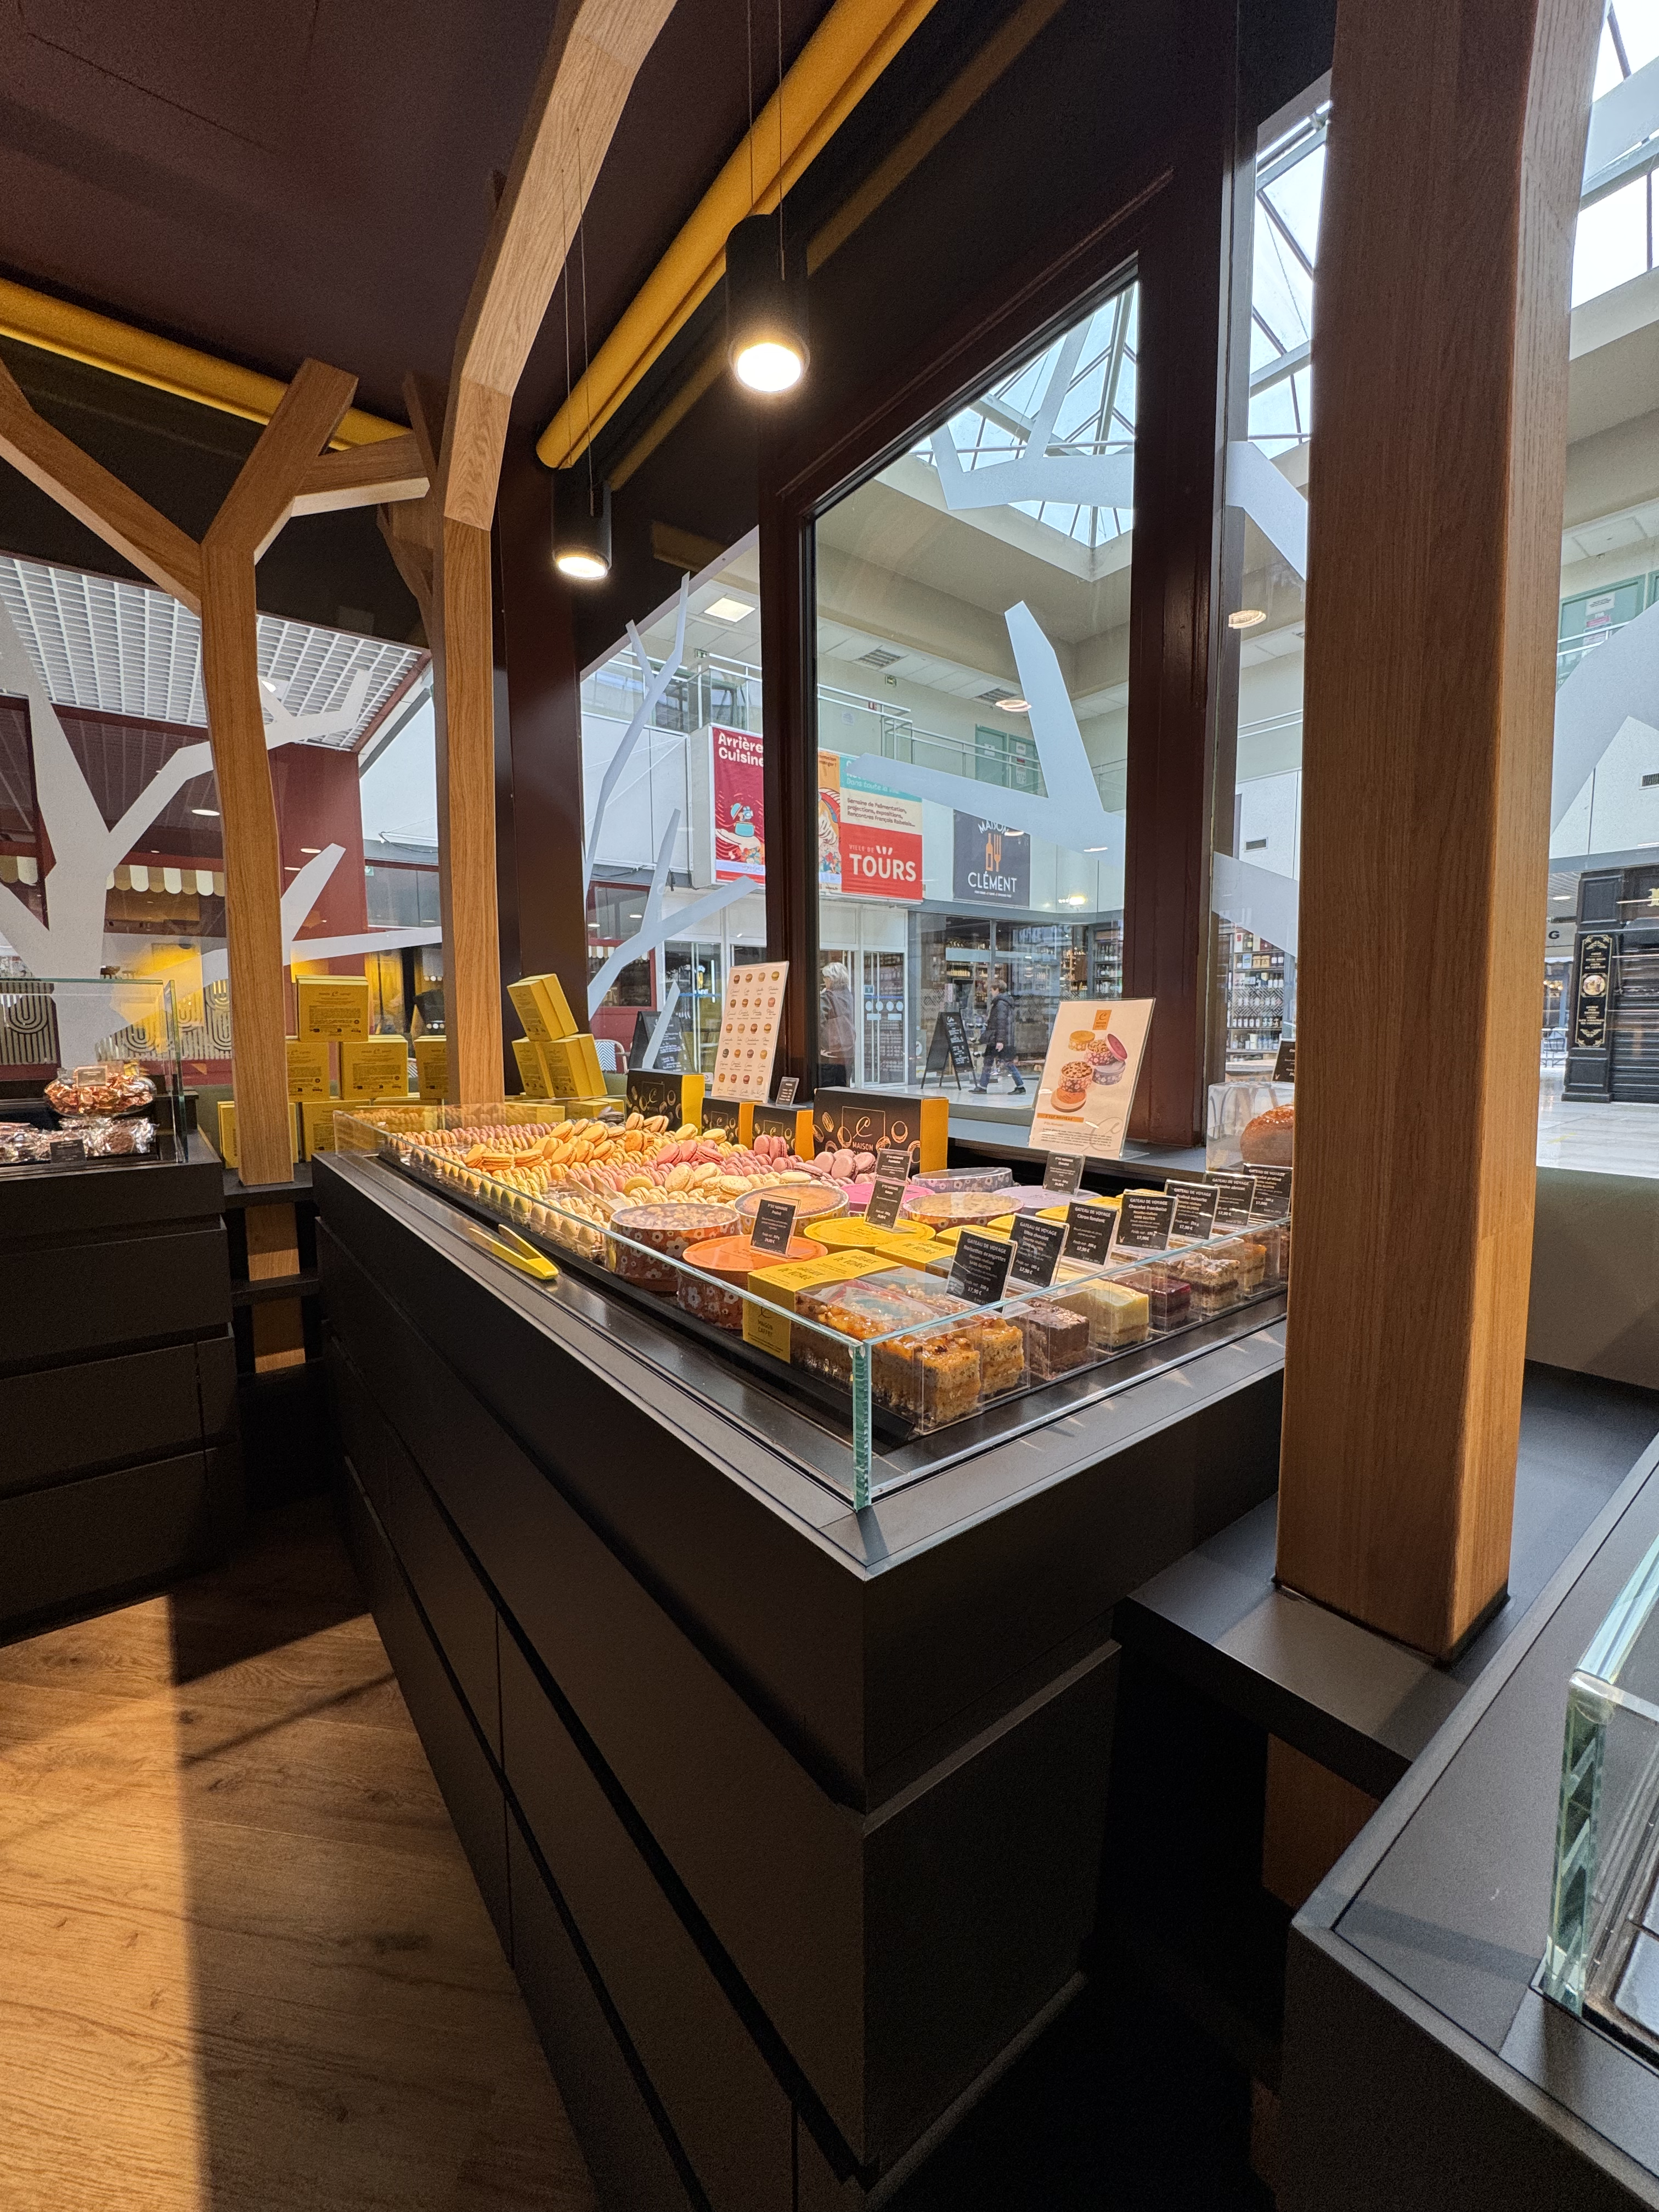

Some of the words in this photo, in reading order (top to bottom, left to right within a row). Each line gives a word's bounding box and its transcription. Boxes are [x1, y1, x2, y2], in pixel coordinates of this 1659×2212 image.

[718, 732, 763, 753] Arrière
[719, 747, 764, 768] Cuisine
[847, 778, 862, 787] Dans
[864, 781, 881, 790] toute
[848, 805, 875, 814] projections,
[876, 810, 903, 820] expositions,
[848, 811, 874, 820] Rencontres
[849, 853, 916, 882] TOURS
[968, 871, 1018, 893] CLÉMENT
[1548, 931, 1560, 939] G
[852, 1141, 873, 1151] MAISON
[1041, 1228, 1057, 1237] VOYAGE
[967, 1238, 983, 1248] GATEAU
[989, 1245, 1007, 1255] VOYAGE
